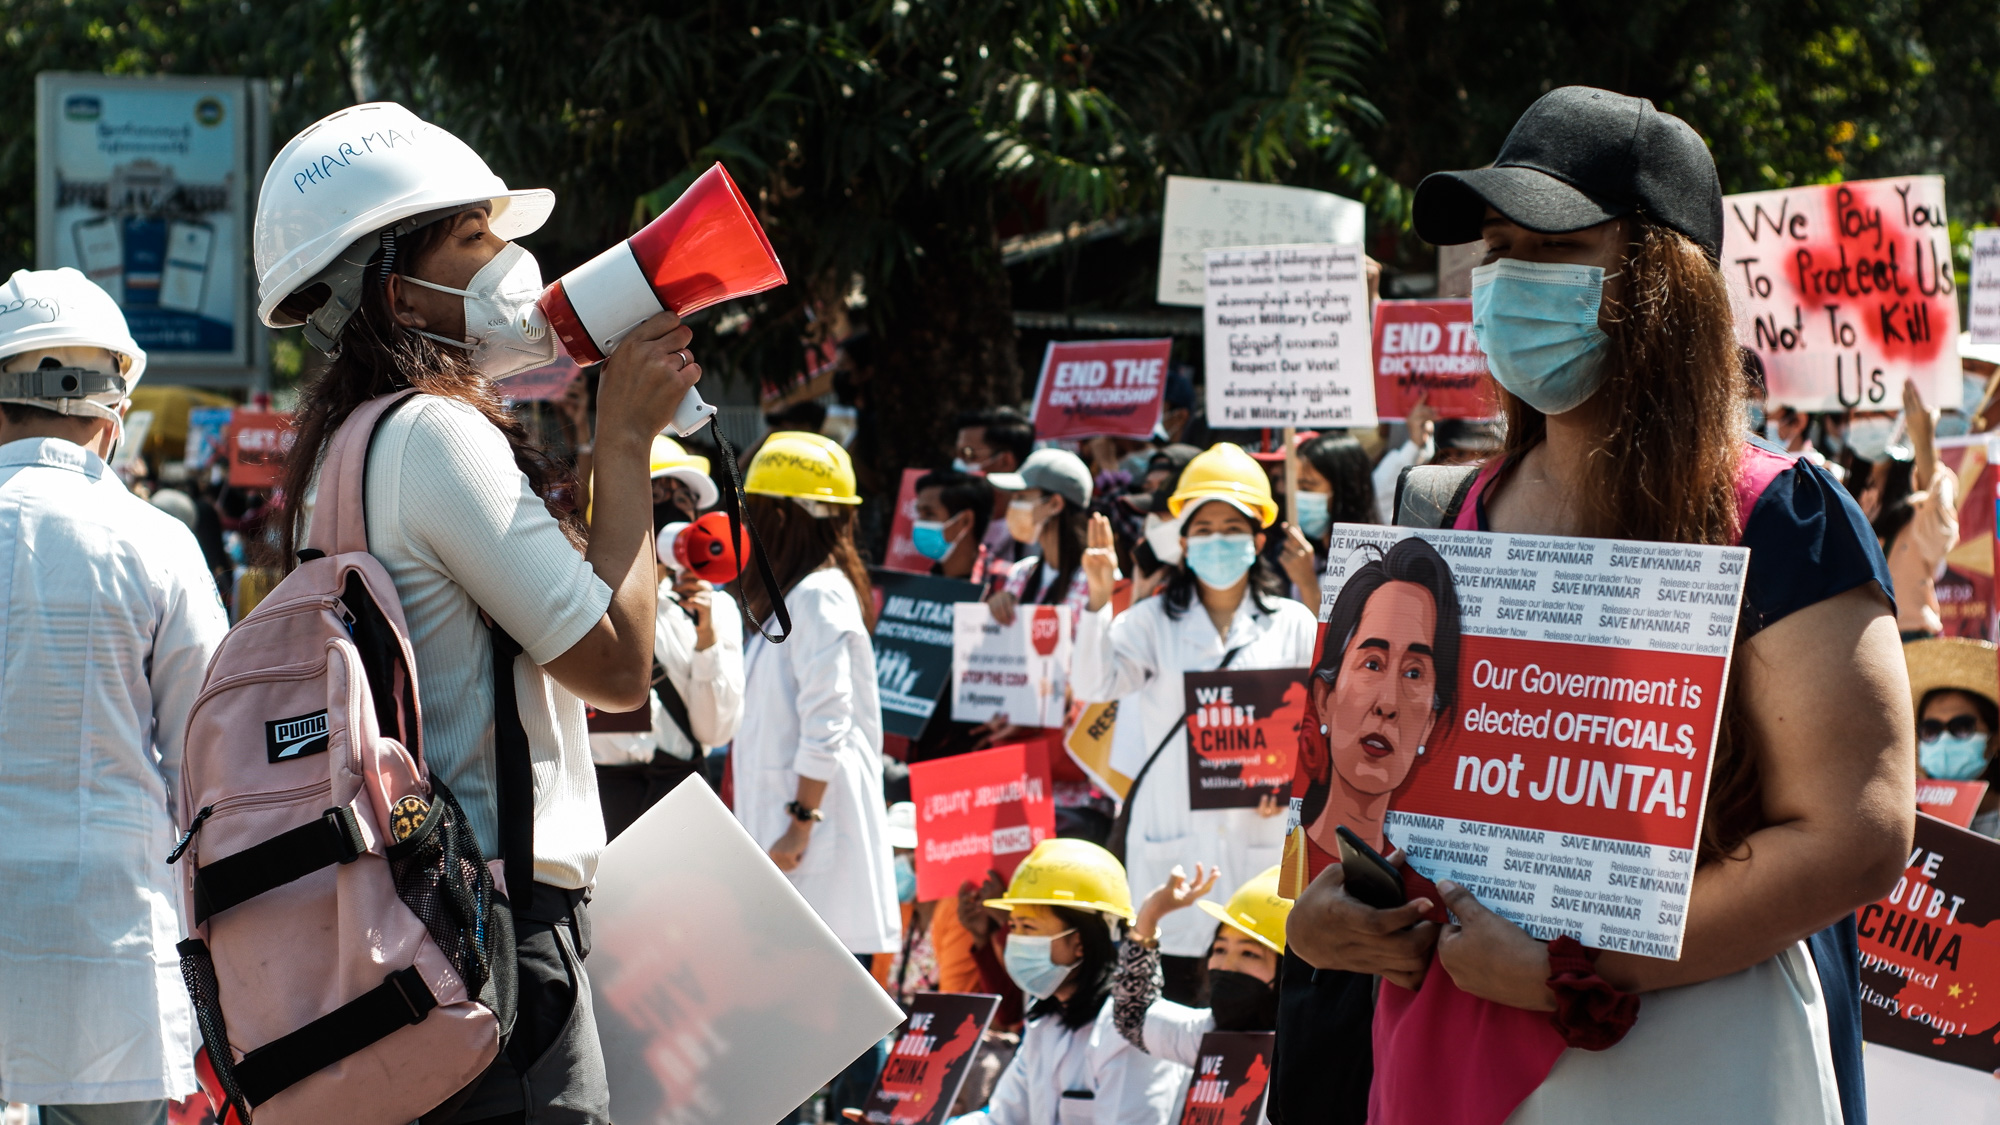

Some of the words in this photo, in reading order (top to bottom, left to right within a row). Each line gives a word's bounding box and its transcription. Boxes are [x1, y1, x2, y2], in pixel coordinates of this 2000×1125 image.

[1733, 196, 1808, 242] We
[1836, 187, 1883, 251] Pay
[1895, 183, 1947, 228] You
[1736, 258, 1772, 299] To
[1796, 240, 1908, 297] Protect
[1915, 239, 1954, 297] Us
[1218, 314, 1256, 329] Reject
[1260, 312, 1306, 327] Military
[1755, 304, 1806, 351] Not
[1824, 304, 1856, 347] To
[1880, 302, 1931, 345] Kill
[1381, 322, 1442, 354] END
[1446, 321, 1480, 353] TH
[1053, 360, 1108, 388] END
[1112, 358, 1164, 386] THE
[1231, 360, 1277, 374] Respect
[1281, 360, 1301, 372] Our
[1837, 352, 1885, 408] Us
[1048, 388, 1158, 407] DICTATORSHIP
[1251, 406, 1298, 422] Military
[1439, 545, 1492, 559] MYANMAR
[1509, 538, 1537, 548] Release
[1538, 541, 1551, 549] our
[1553, 540, 1576, 551] leader
[1578, 542, 1595, 552] Now
[1612, 544, 1641, 555] Release
[1642, 547, 1656, 556] our
[1657, 546, 1682, 557] leader
[1684, 549, 1703, 558] Now
[1507, 548, 1535, 563] SAVE
[1536, 550, 1594, 565] MYANMAR
[1609, 554, 1639, 569] SAVE
[1640, 557, 1701, 572] MYANMAR
[1455, 564, 1482, 573] Release
[1483, 567, 1495, 576] our
[1495, 566, 1519, 577] leader
[1520, 568, 1538, 578] Now
[1554, 570, 1583, 581] Release
[1584, 574, 1597, 582] our
[1598, 572, 1623, 583] leader
[1625, 576, 1643, 585] Now
[1453, 575, 1480, 588] SAVE
[1481, 576, 1536, 591] MYANMAR
[1551, 582, 1580, 595] SAVE
[1581, 584, 1640, 599] MYANMAR
[1660, 578, 1689, 589] Release
[1692, 582, 1705, 590] our
[1707, 580, 1731, 591] leader
[1499, 596, 1527, 607] Release
[1528, 600, 1541, 608] our
[1541, 598, 1565, 609] leader
[1567, 602, 1585, 611] Now
[1657, 589, 1686, 602] SAVE
[1688, 590, 1737, 606] MYANM
[883, 594, 954, 626] MILITAR
[1496, 607, 1524, 621] SAVE
[1526, 609, 1583, 625] MYANMAR
[1601, 604, 1630, 615] Release
[1631, 608, 1646, 617] our
[1647, 606, 1672, 618] leader
[1674, 610, 1692, 620] Now
[1032, 617, 1058, 640] STOP
[1599, 615, 1628, 629] SAVE
[1629, 618, 1690, 634] MYANMAR
[1472, 659, 1519, 691] Our
[1521, 664, 1678, 708] Government
[1680, 677, 1702, 709] is
[1195, 686, 1233, 705] WE
[1197, 704, 1256, 728] DOUBT
[278, 715, 326, 740] PUMA
[1464, 702, 1551, 739] elected
[1553, 712, 1697, 760] OFFICIALS,
[1201, 728, 1267, 752] CHINA
[974, 773, 1044, 807] Myanmar
[1200, 776, 1246, 790] Military
[1453, 753, 1525, 798] not
[1529, 756, 1693, 819] JUNTA!
[923, 788, 973, 822] Junta?
[1393, 811, 1445, 831] MYANMAR
[1409, 833, 1435, 846] Release
[1435, 838, 1449, 847] our
[1449, 838, 1471, 851] leader
[1473, 843, 1490, 854] Now
[1459, 821, 1487, 837] SAVE
[1488, 826, 1545, 844] MYANMAR
[925, 832, 992, 865] supporting
[1406, 845, 1432, 859] SAVE
[1433, 848, 1488, 867] MYANMAR
[1506, 848, 1535, 860] Release
[1536, 853, 1550, 862] our
[1550, 852, 1574, 865] leader
[1576, 857, 1594, 868] Now
[1561, 835, 1590, 851] SAVE
[1591, 839, 1652, 859] MYANMAR
[1451, 870, 1478, 882] Release
[1480, 874, 1493, 883] our
[1493, 874, 1517, 888] leader
[1519, 880, 1537, 891] Now
[1504, 858, 1532, 874] SAVE
[1533, 862, 1592, 882] MYANMAR
[1477, 885, 1535, 905] MYANMAR
[1553, 884, 1583, 898] Release
[1584, 890, 1598, 899] our
[1599, 889, 1623, 903] leader
[1625, 895, 1643, 906] Now
[1889, 876, 1965, 926] OUBT
[1551, 896, 1580, 912] SAVE
[1581, 900, 1641, 920] MYANMAR
[1858, 903, 1963, 972] CHINA
[1857, 949, 1939, 991] upported
[1859, 982, 1904, 1016] litary
[909, 1012, 935, 1031] WE
[896, 1034, 937, 1057] DOUBT
[886, 1058, 929, 1085] CHINA
[1201, 1055, 1224, 1075] WE
[1191, 1079, 1229, 1104] DOUBT
